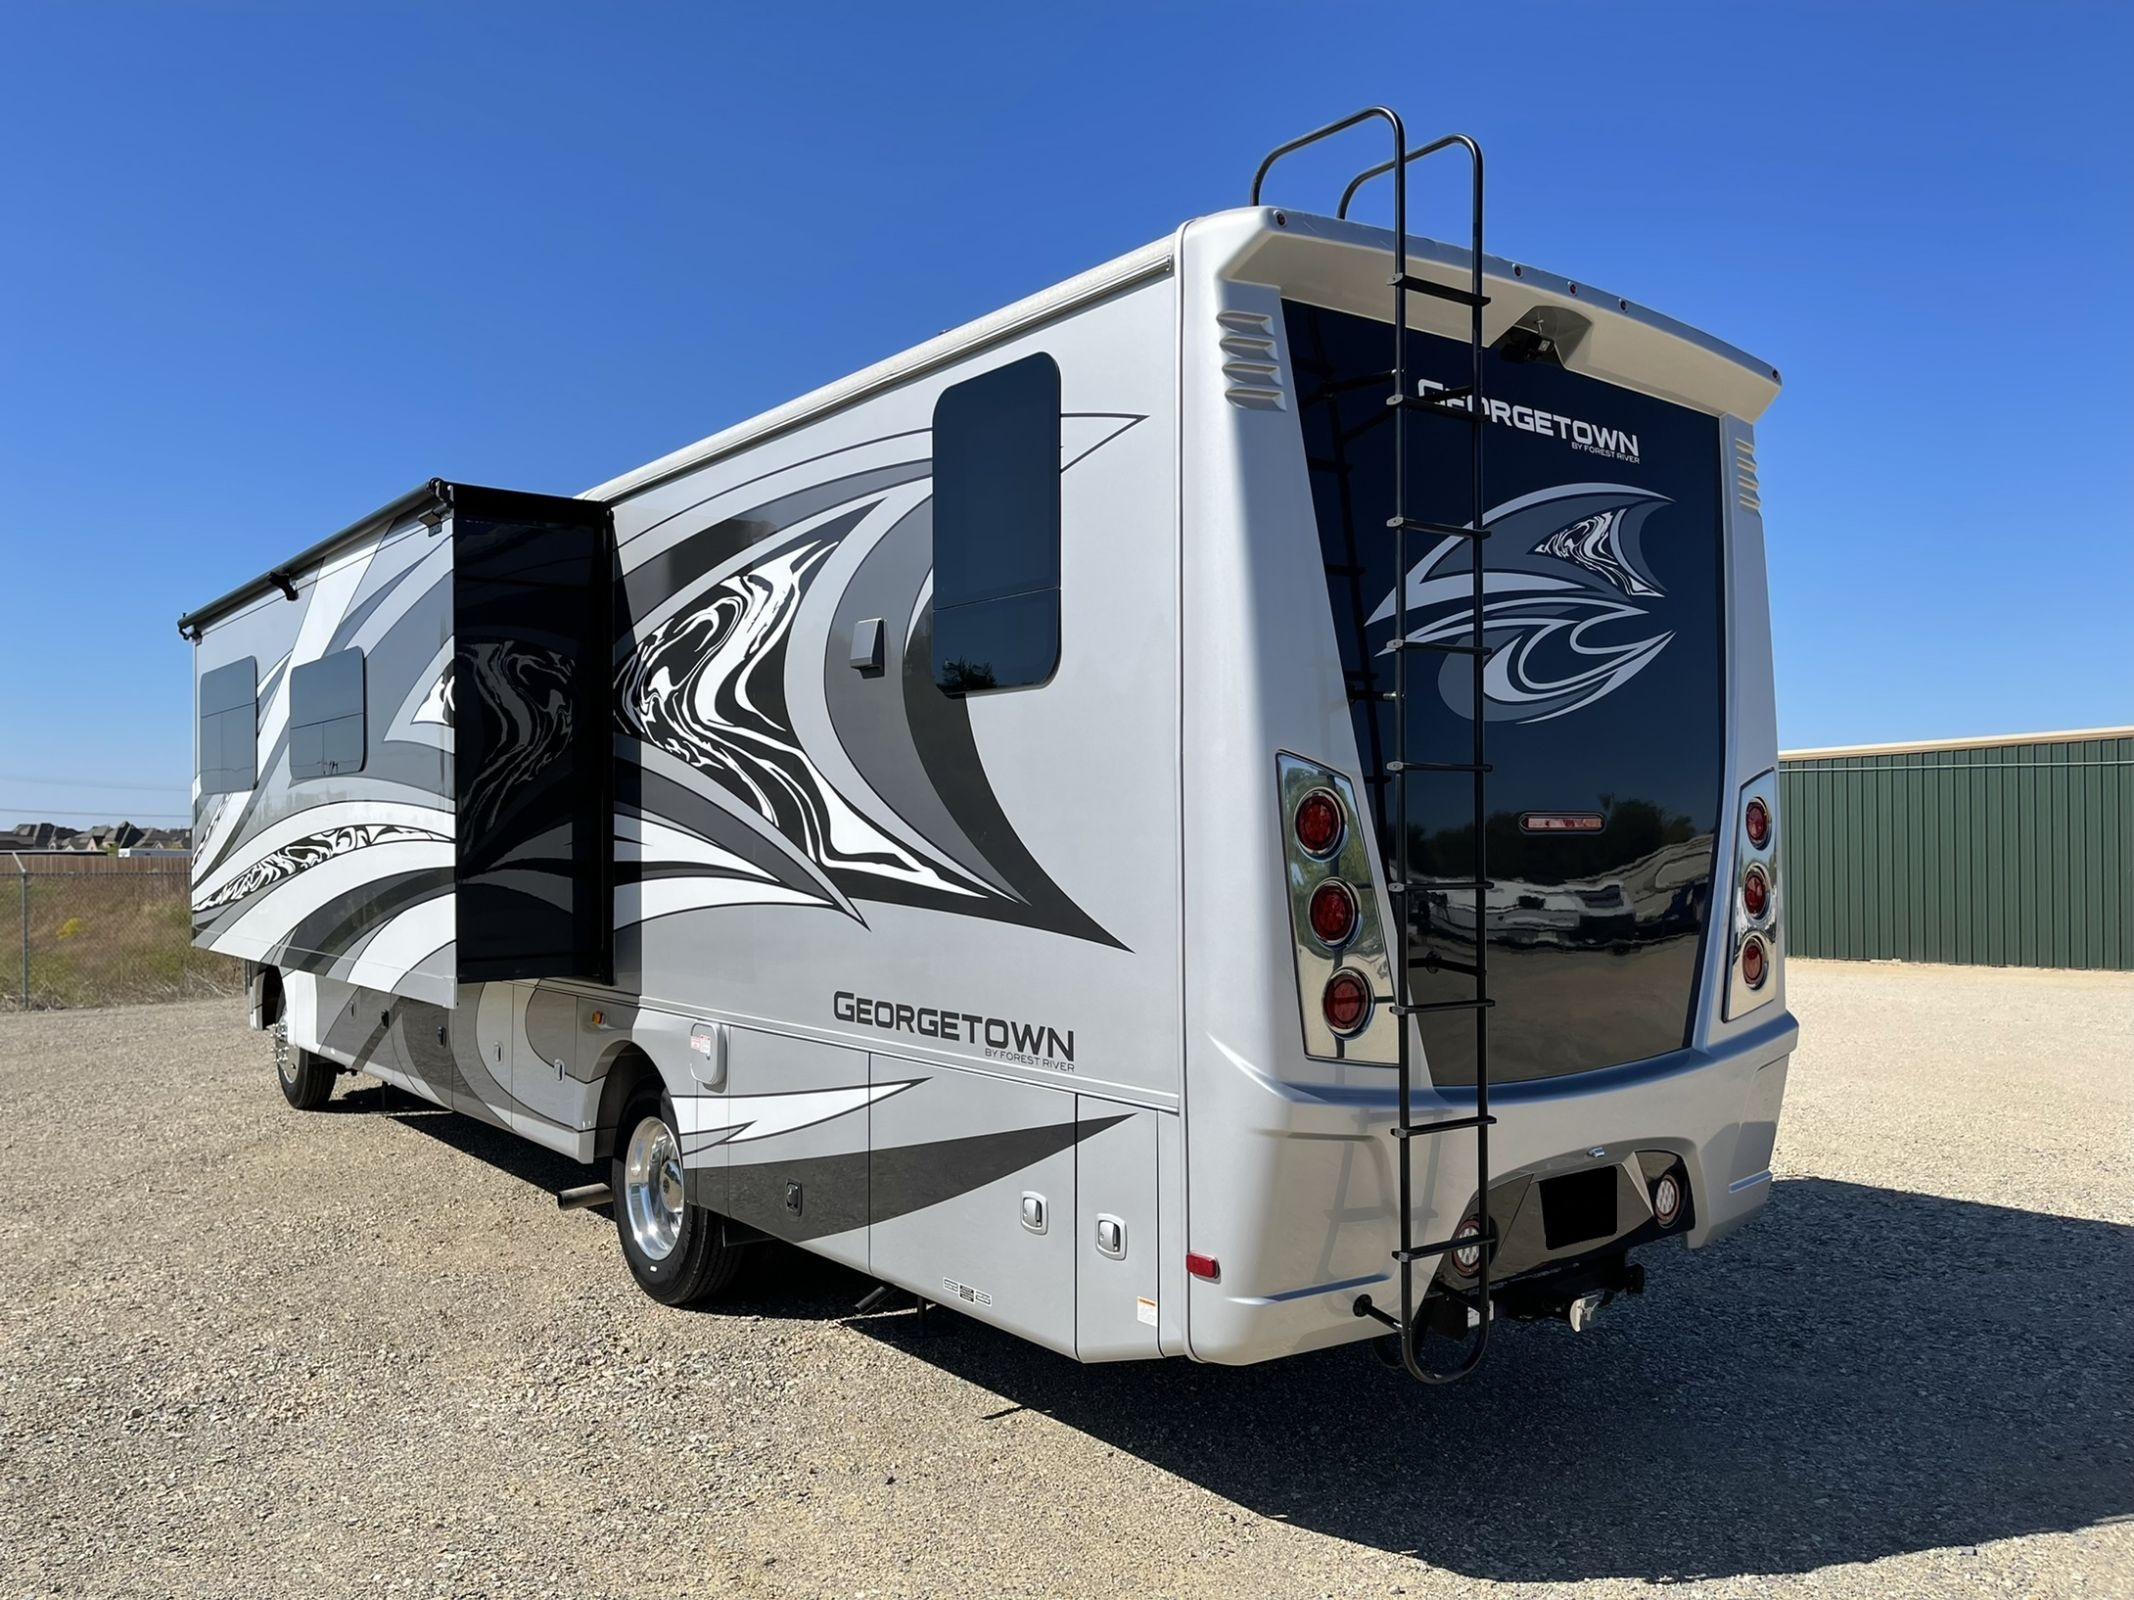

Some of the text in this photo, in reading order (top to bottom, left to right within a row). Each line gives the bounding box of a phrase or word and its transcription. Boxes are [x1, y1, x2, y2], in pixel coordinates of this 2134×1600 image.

[1571, 441, 1640, 464] BY FOREST RIVER
[833, 990, 1075, 1062] GEORGETOWN
[985, 1047, 1075, 1072] BY FOREST RIVER
